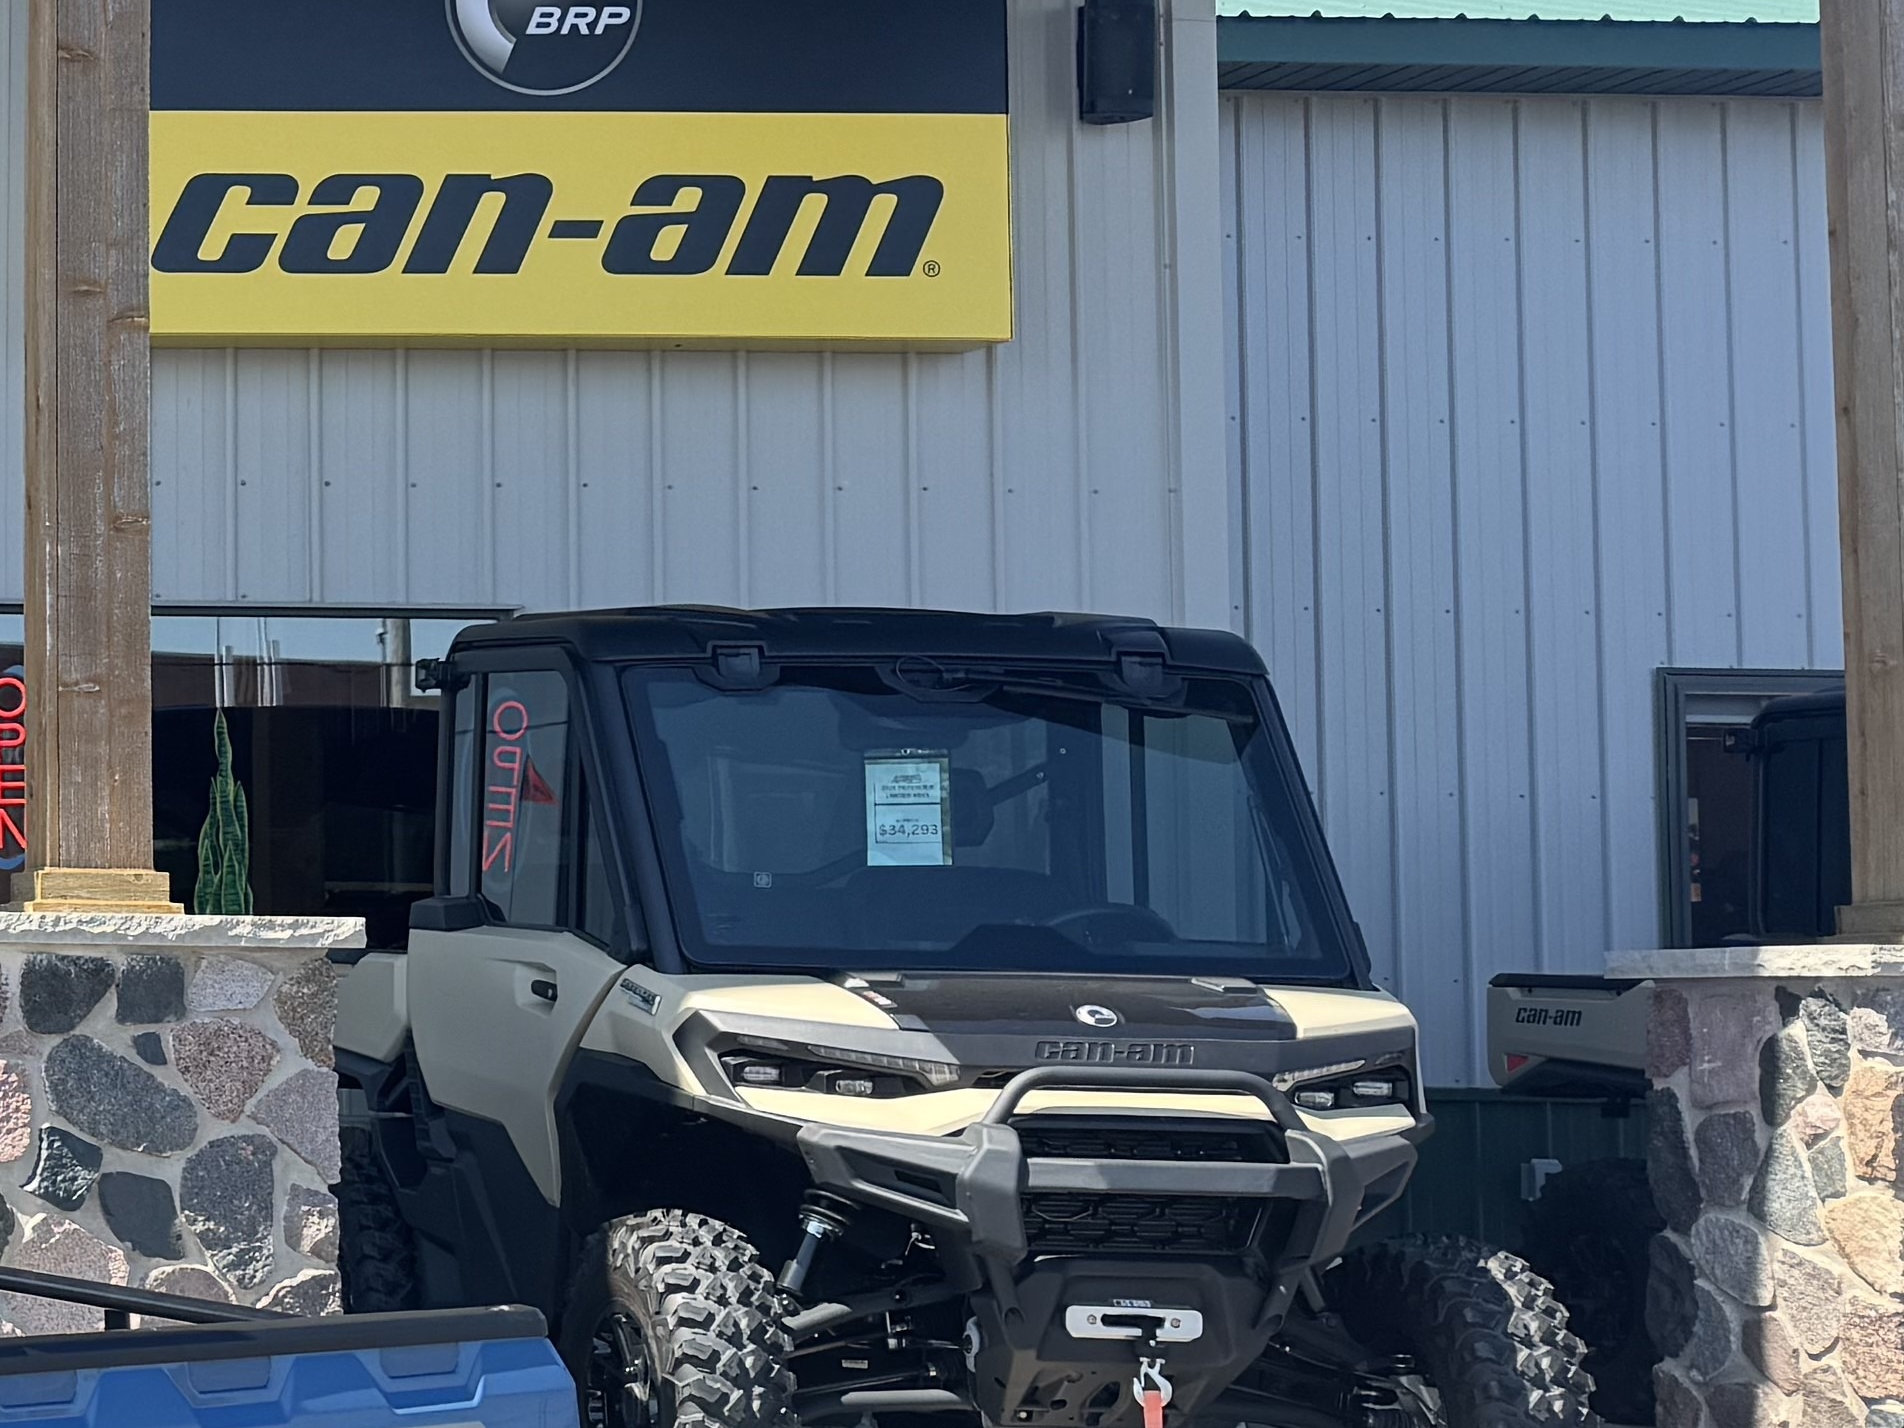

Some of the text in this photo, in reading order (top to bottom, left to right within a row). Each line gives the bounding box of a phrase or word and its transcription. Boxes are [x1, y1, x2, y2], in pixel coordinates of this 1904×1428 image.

[525, 6, 631, 36] BRP
[149, 172, 944, 277] can-am
[879, 824, 939, 838] $34,293
[1516, 1007, 1582, 1026] can-am
[1035, 1041, 1194, 1065] can-am
